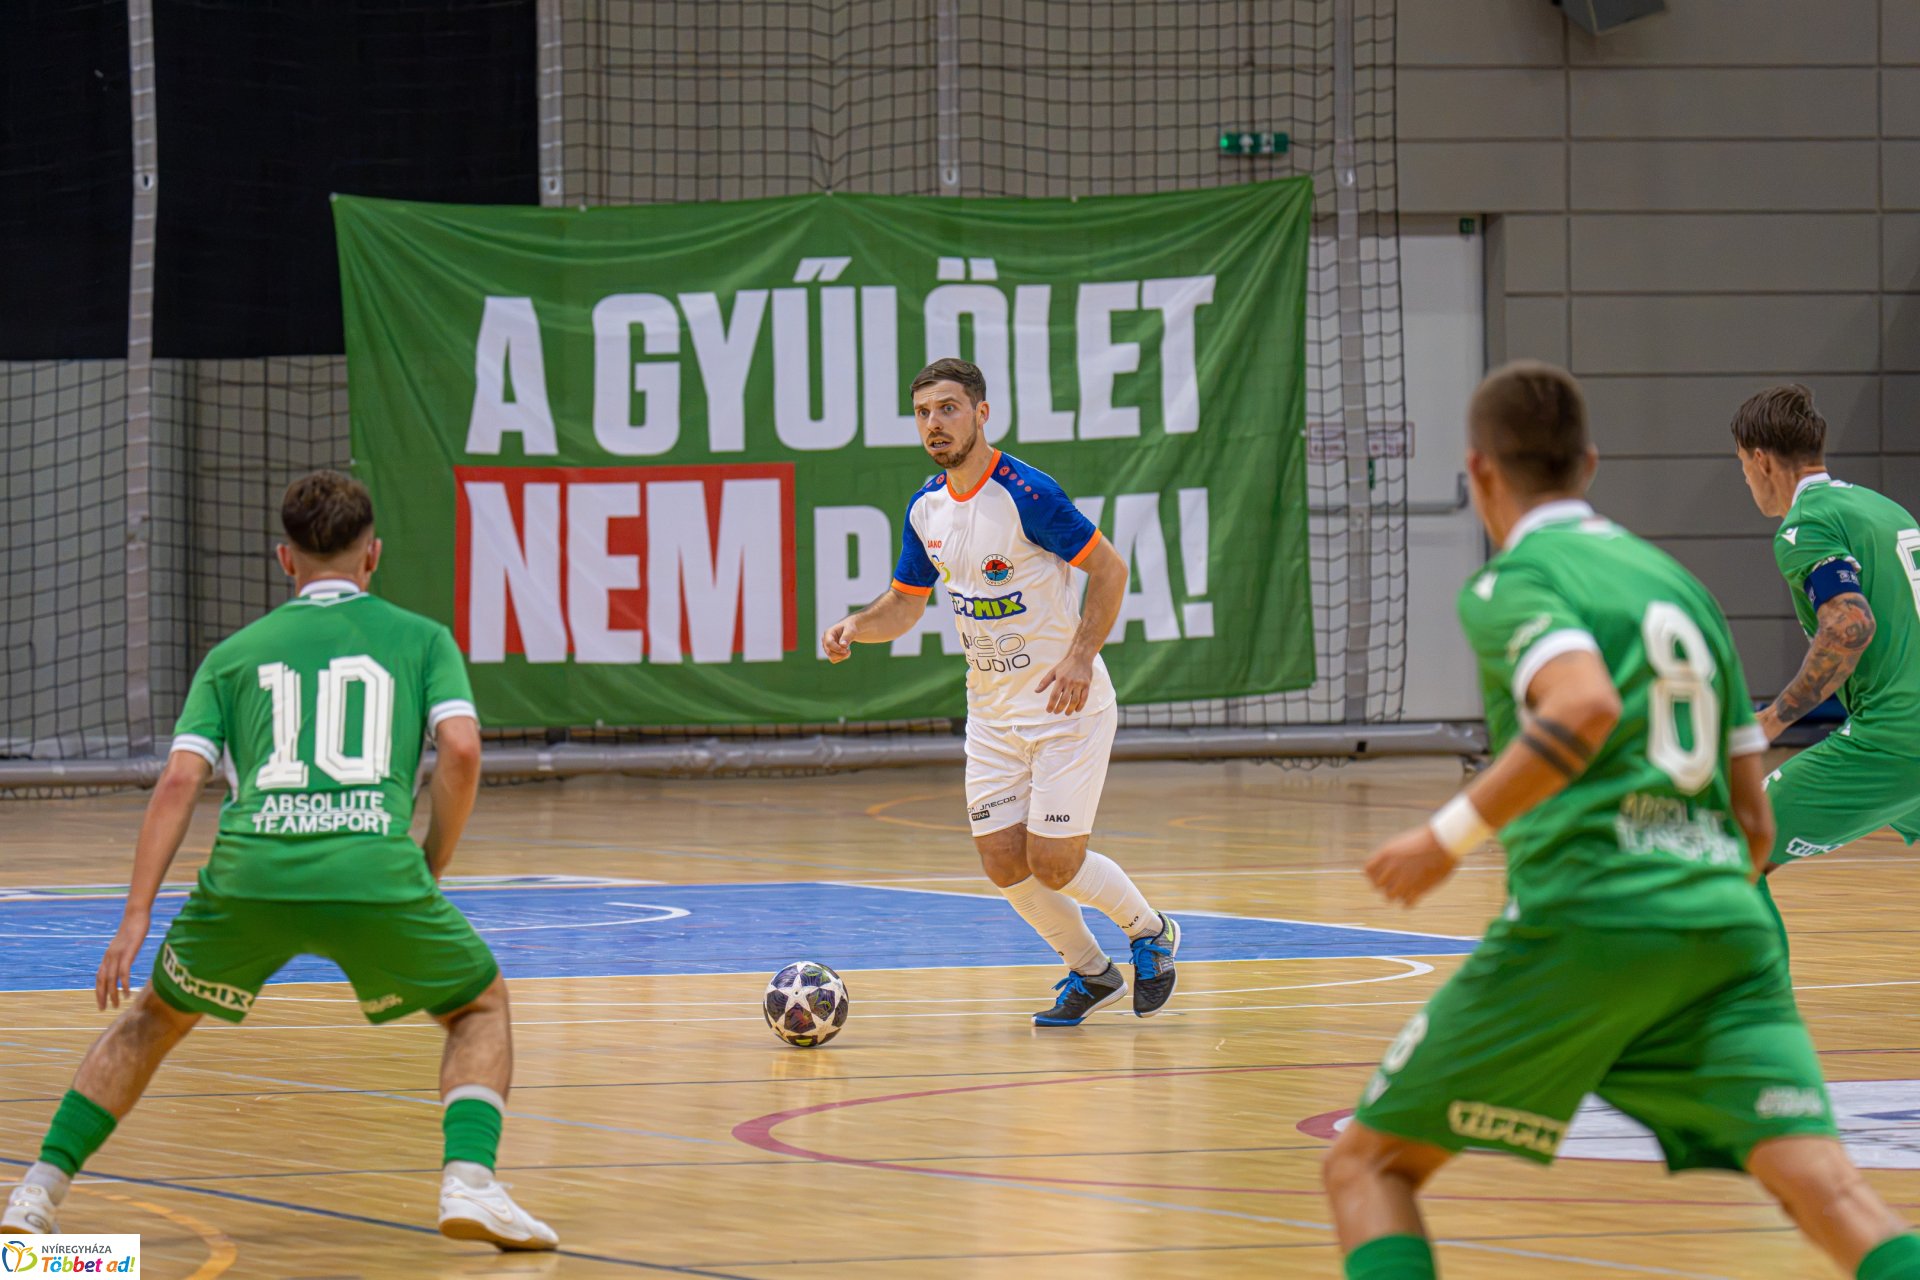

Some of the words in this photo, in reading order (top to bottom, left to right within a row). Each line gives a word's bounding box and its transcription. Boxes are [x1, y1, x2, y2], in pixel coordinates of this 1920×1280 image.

[466, 296, 558, 456] A
[592, 257, 1216, 456] GYŰLÖLET
[464, 477, 784, 664] NEM
[968, 654, 1031, 672] UDIO
[1642, 600, 1720, 796] 8
[255, 654, 395, 790] 10
[252, 812, 392, 836] TEAMSPORT
[261, 790, 385, 814] ABSOLUTE
[1044, 814, 1070, 822] JAKO
